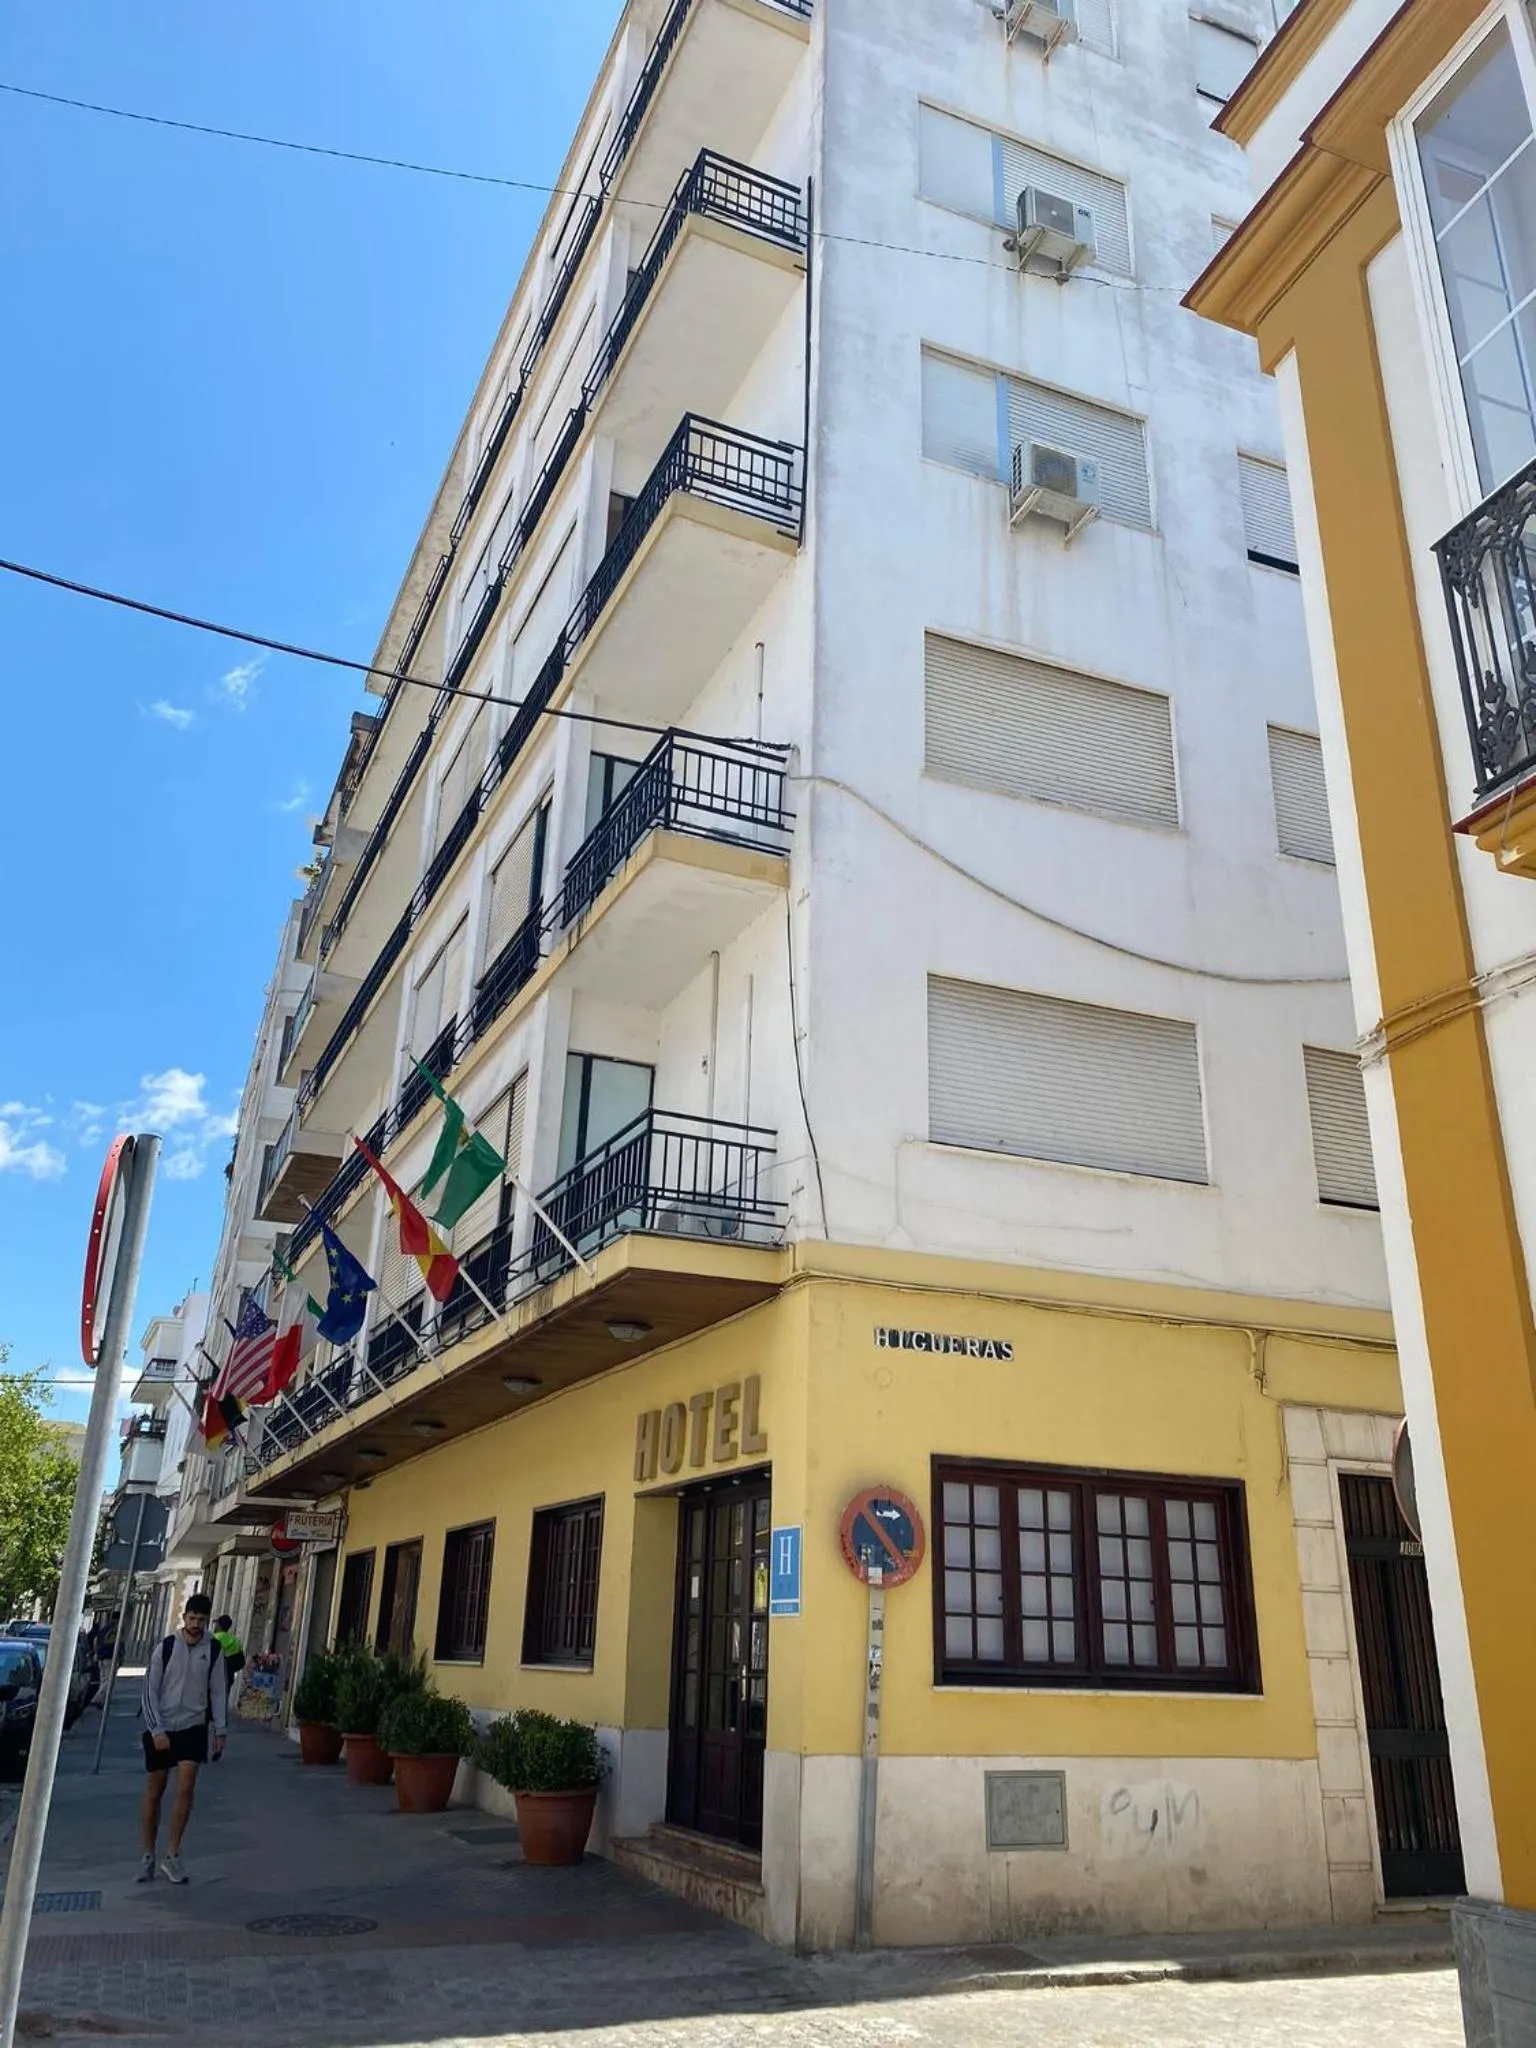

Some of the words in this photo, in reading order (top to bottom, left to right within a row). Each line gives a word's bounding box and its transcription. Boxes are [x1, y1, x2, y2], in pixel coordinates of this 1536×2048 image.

[874, 1327, 1014, 1361] HIGUERAS
[633, 1374, 768, 1482] HOTEL
[778, 1535, 793, 1575] H
